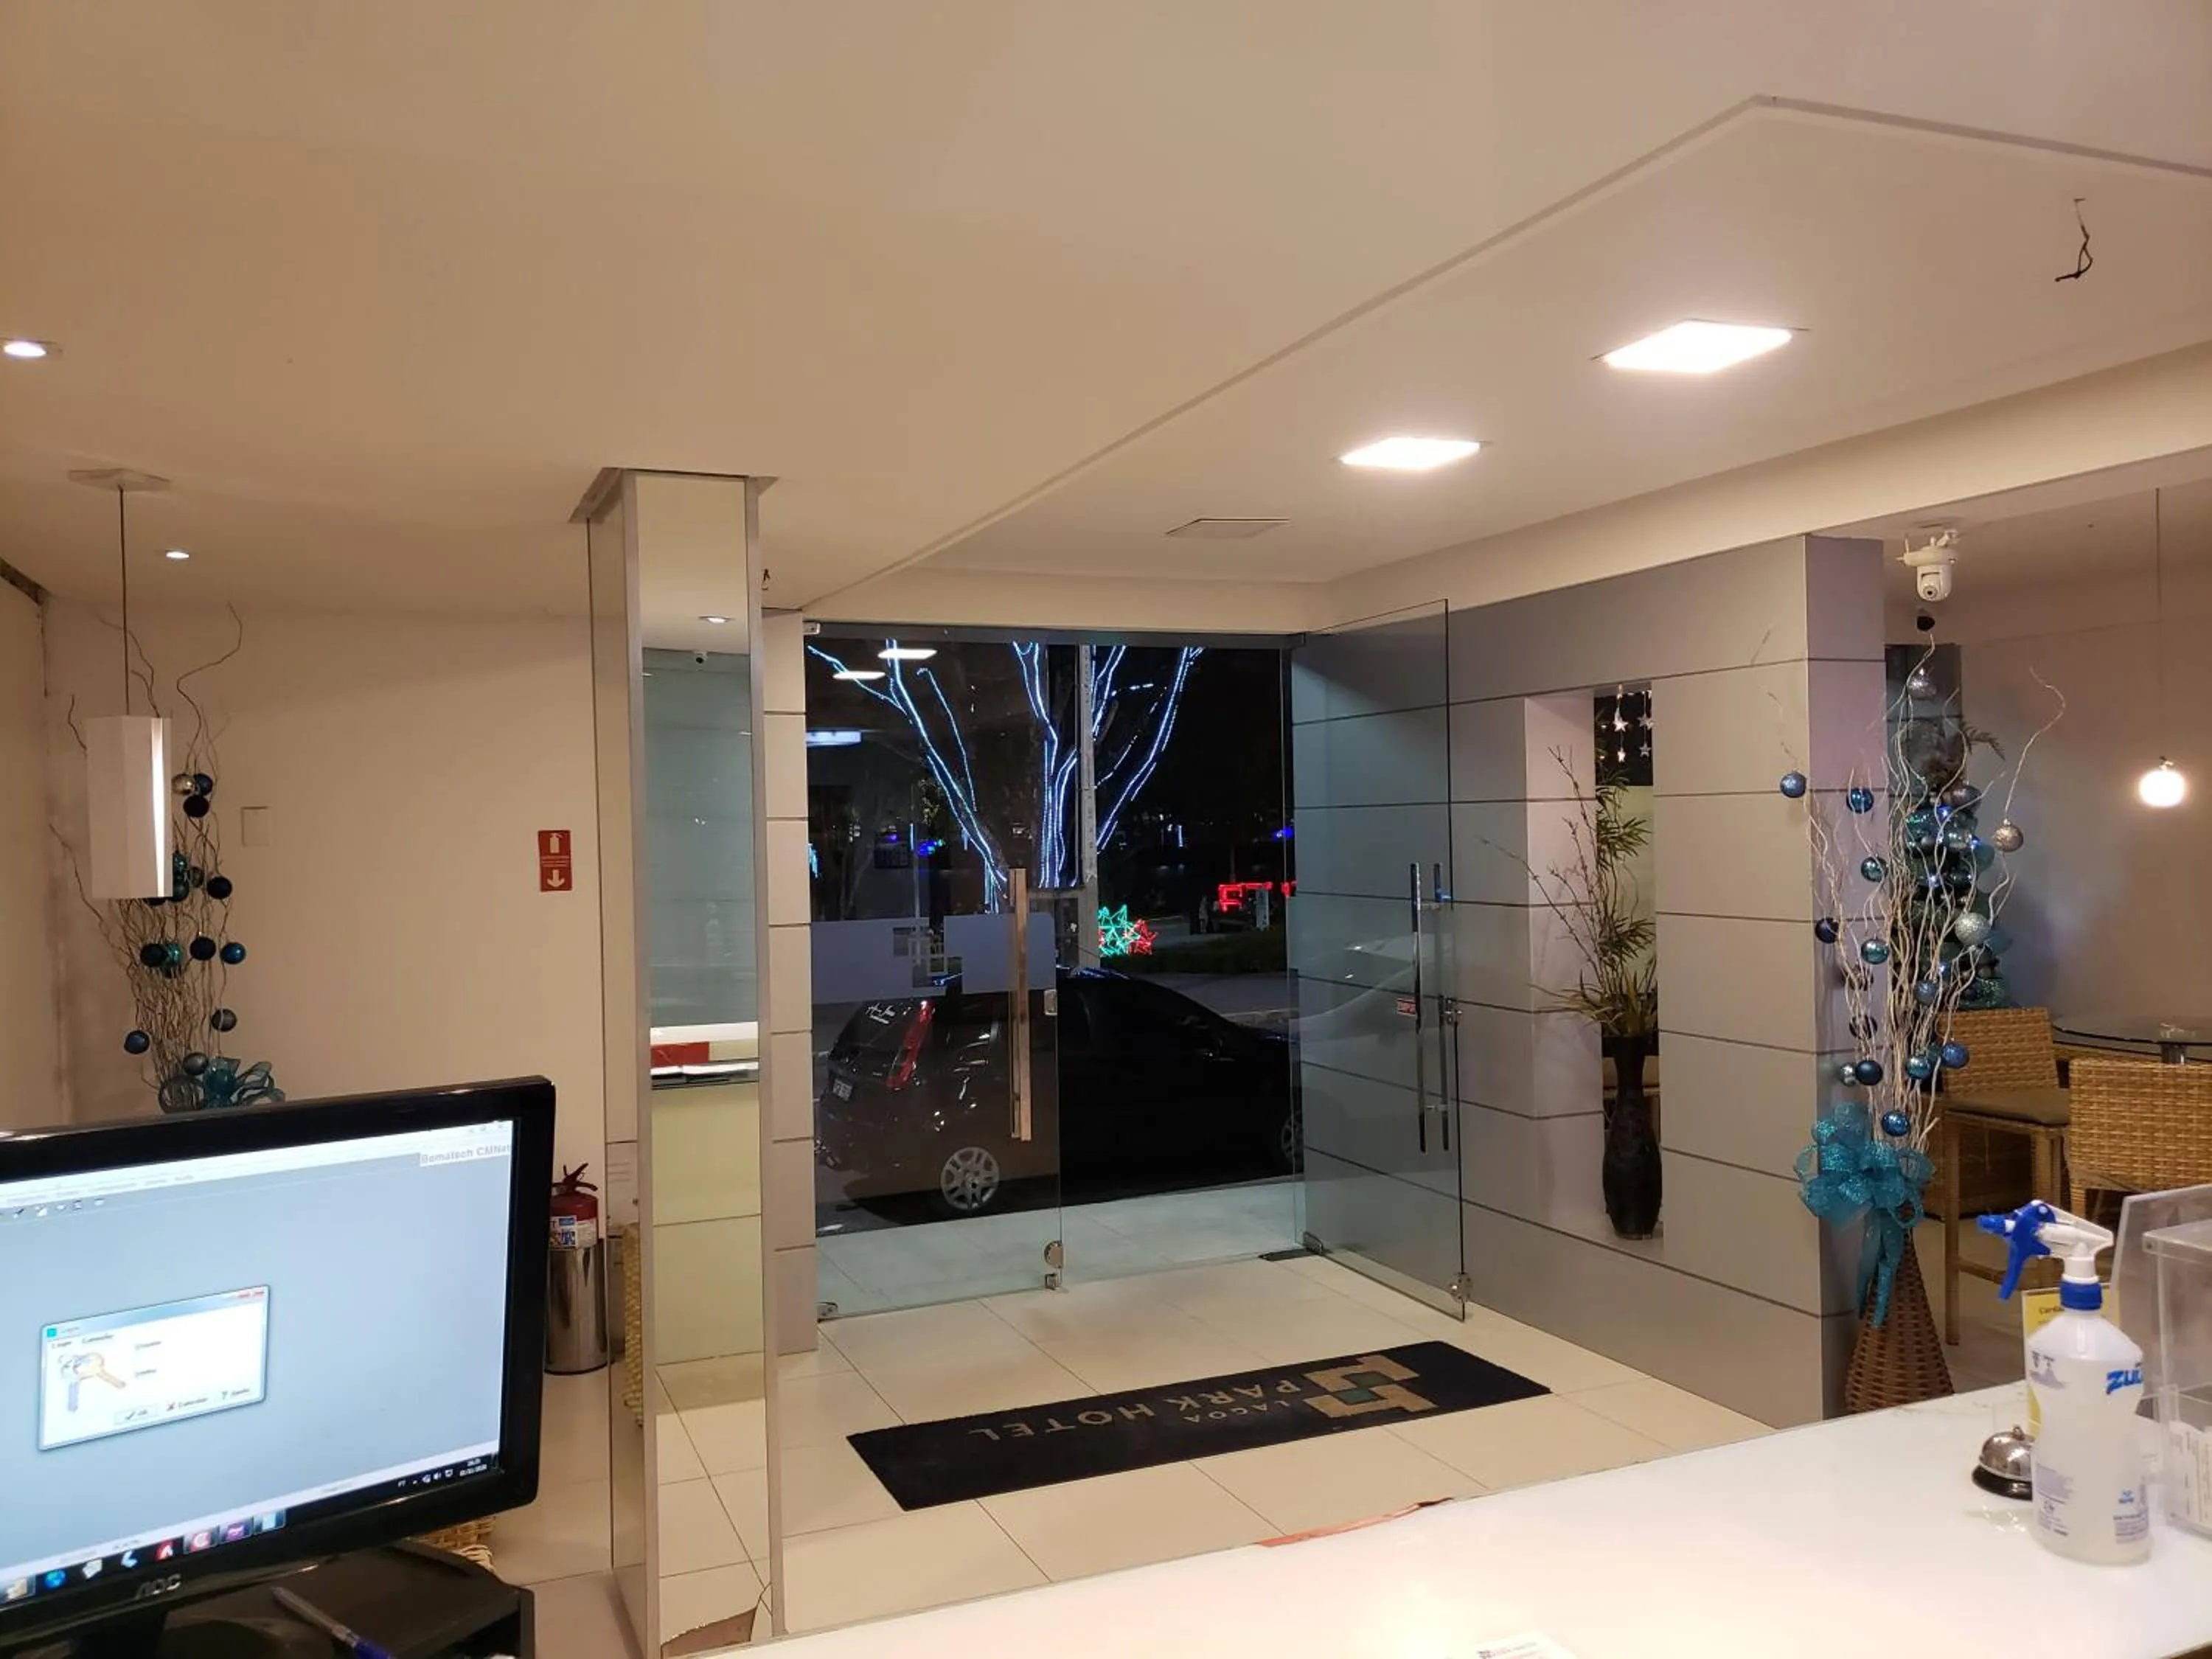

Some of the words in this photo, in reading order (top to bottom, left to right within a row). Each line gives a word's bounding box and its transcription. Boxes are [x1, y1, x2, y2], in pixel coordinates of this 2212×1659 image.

[1163, 1380, 1301, 1412] PARK
[967, 1402, 1155, 1441] HOTEL
[1183, 1400, 1290, 1423] LAGOA
[136, 1573, 181, 1600] AOC
